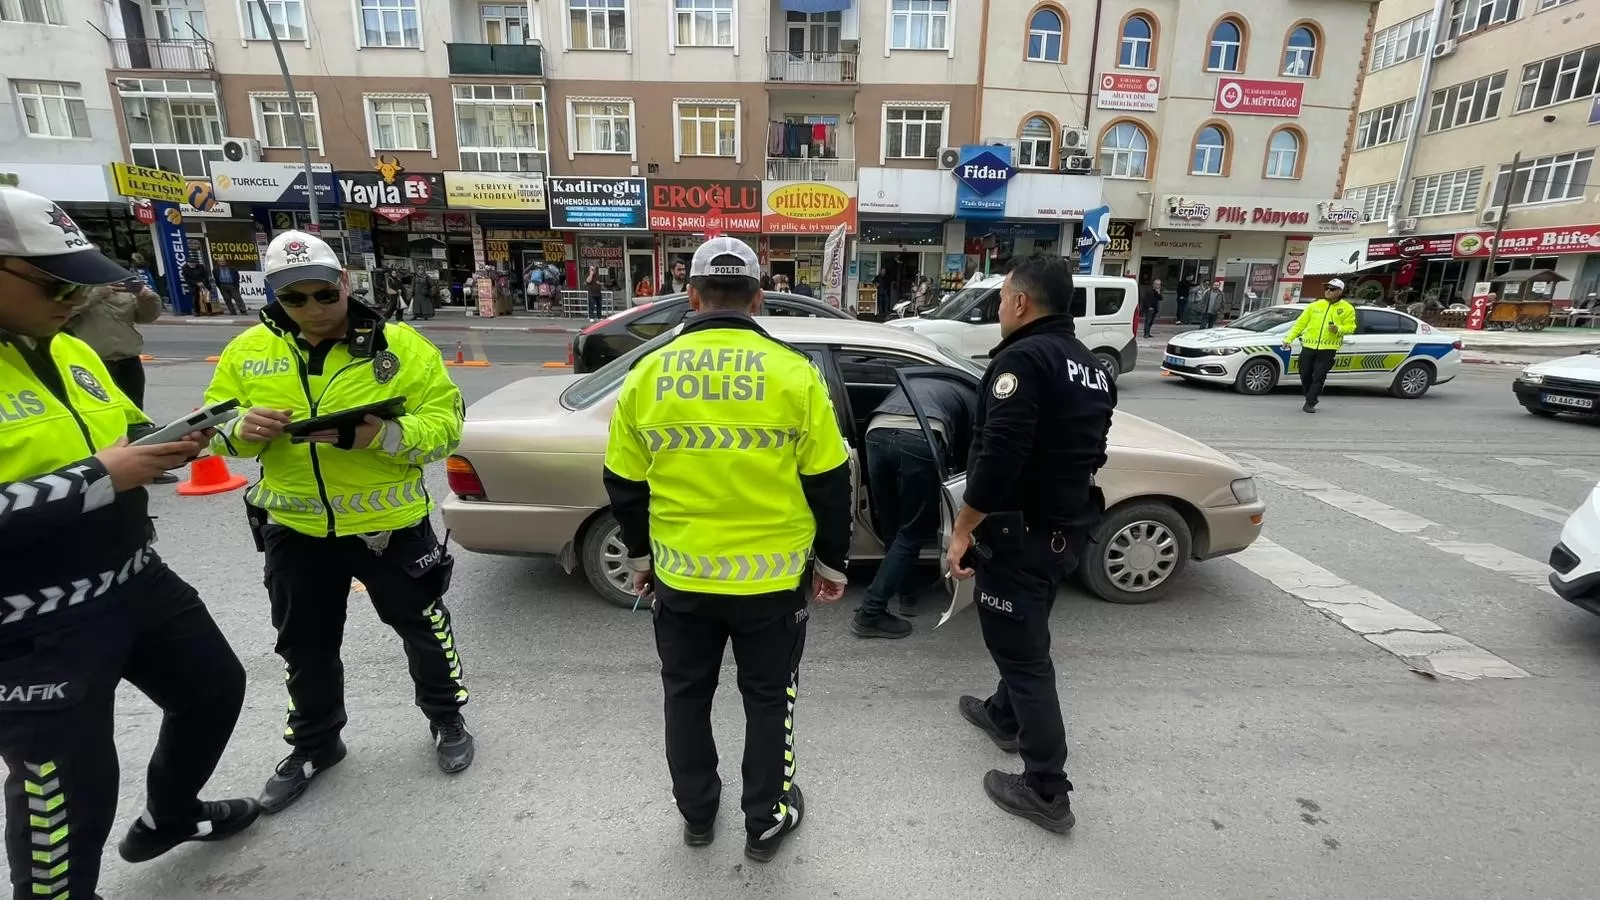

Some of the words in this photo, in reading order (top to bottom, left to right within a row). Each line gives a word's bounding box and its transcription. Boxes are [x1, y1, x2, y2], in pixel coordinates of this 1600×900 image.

[1243, 95, 1250, 105] İL
[1251, 96, 1297, 108] MÜFTÜLÜĞÜ
[126, 165, 180, 183] ERCAN
[963, 165, 1006, 179] Fidan
[128, 177, 184, 195] İLETİŞİM
[232, 178, 279, 187] TURKCELL
[552, 180, 640, 198] Kadiroğlu
[339, 180, 401, 208] Yayla
[404, 181, 428, 198] Et
[473, 192, 516, 200] KİTABEVİ
[553, 197, 600, 206] MÜHENDİSLİK
[653, 184, 757, 210] EROĞLU
[776, 188, 845, 212] PİLİÇİSTAN
[651, 216, 671, 227] GIDA
[730, 218, 760, 229] MANAV
[1216, 206, 1247, 224] Piliç
[1251, 207, 1309, 228] Dünyası
[770, 222, 780, 232] iyi
[782, 223, 798, 232] piliç
[810, 224, 818, 232] iyi
[1078, 236, 1093, 246] Fidan
[1540, 231, 1590, 246] Büfe
[286, 256, 311, 264] POLİS
[1471, 298, 1484, 326] ÇAY
[242, 357, 290, 377] POLİS
[660, 348, 767, 373] TRAFİK
[656, 374, 765, 401] POLİSİ
[980, 592, 1013, 612] POLİS
